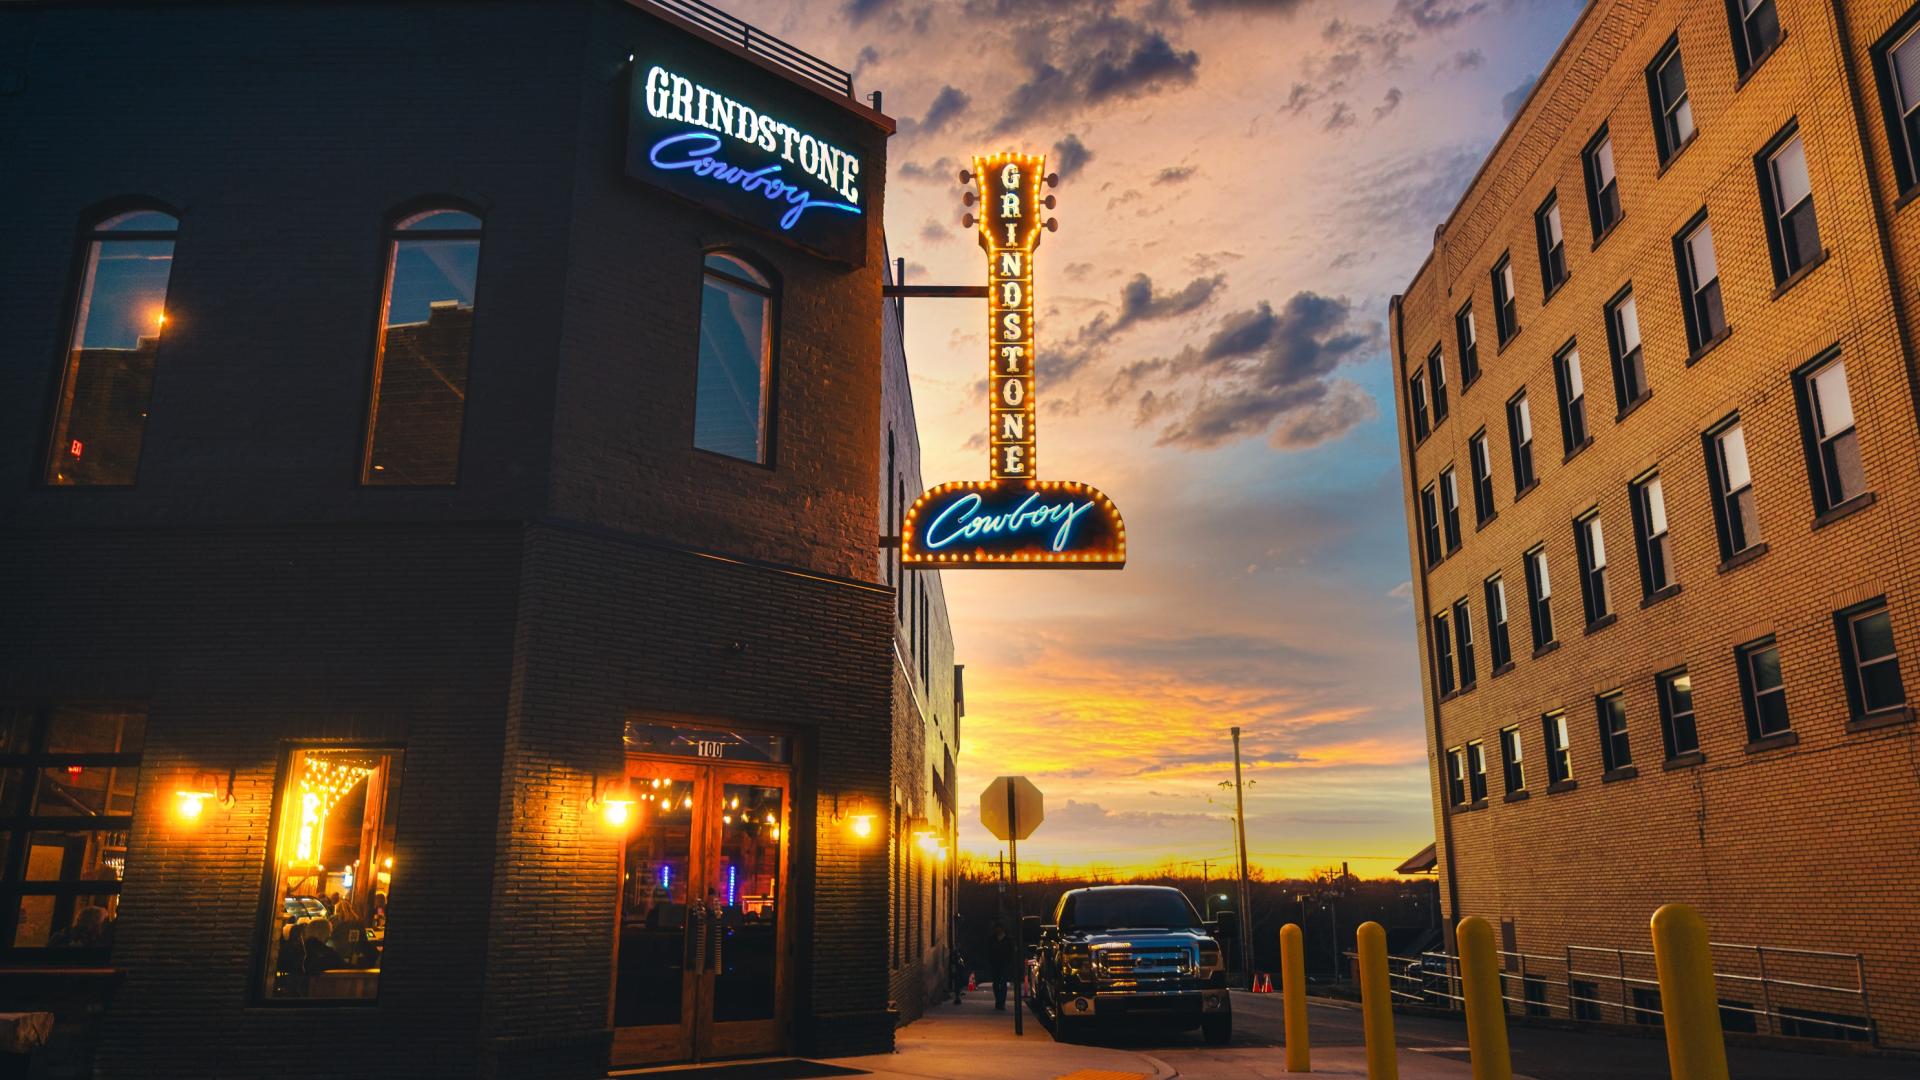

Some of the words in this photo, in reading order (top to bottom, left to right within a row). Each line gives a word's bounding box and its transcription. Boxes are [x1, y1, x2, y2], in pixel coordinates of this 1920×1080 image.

[645, 65, 860, 205] GRINDSTONE
[649, 132, 862, 230] Cowboy
[1000, 163, 1025, 474] GRINDSTONE
[925, 491, 1095, 552] Cowboy
[700, 741, 721, 757] 100
